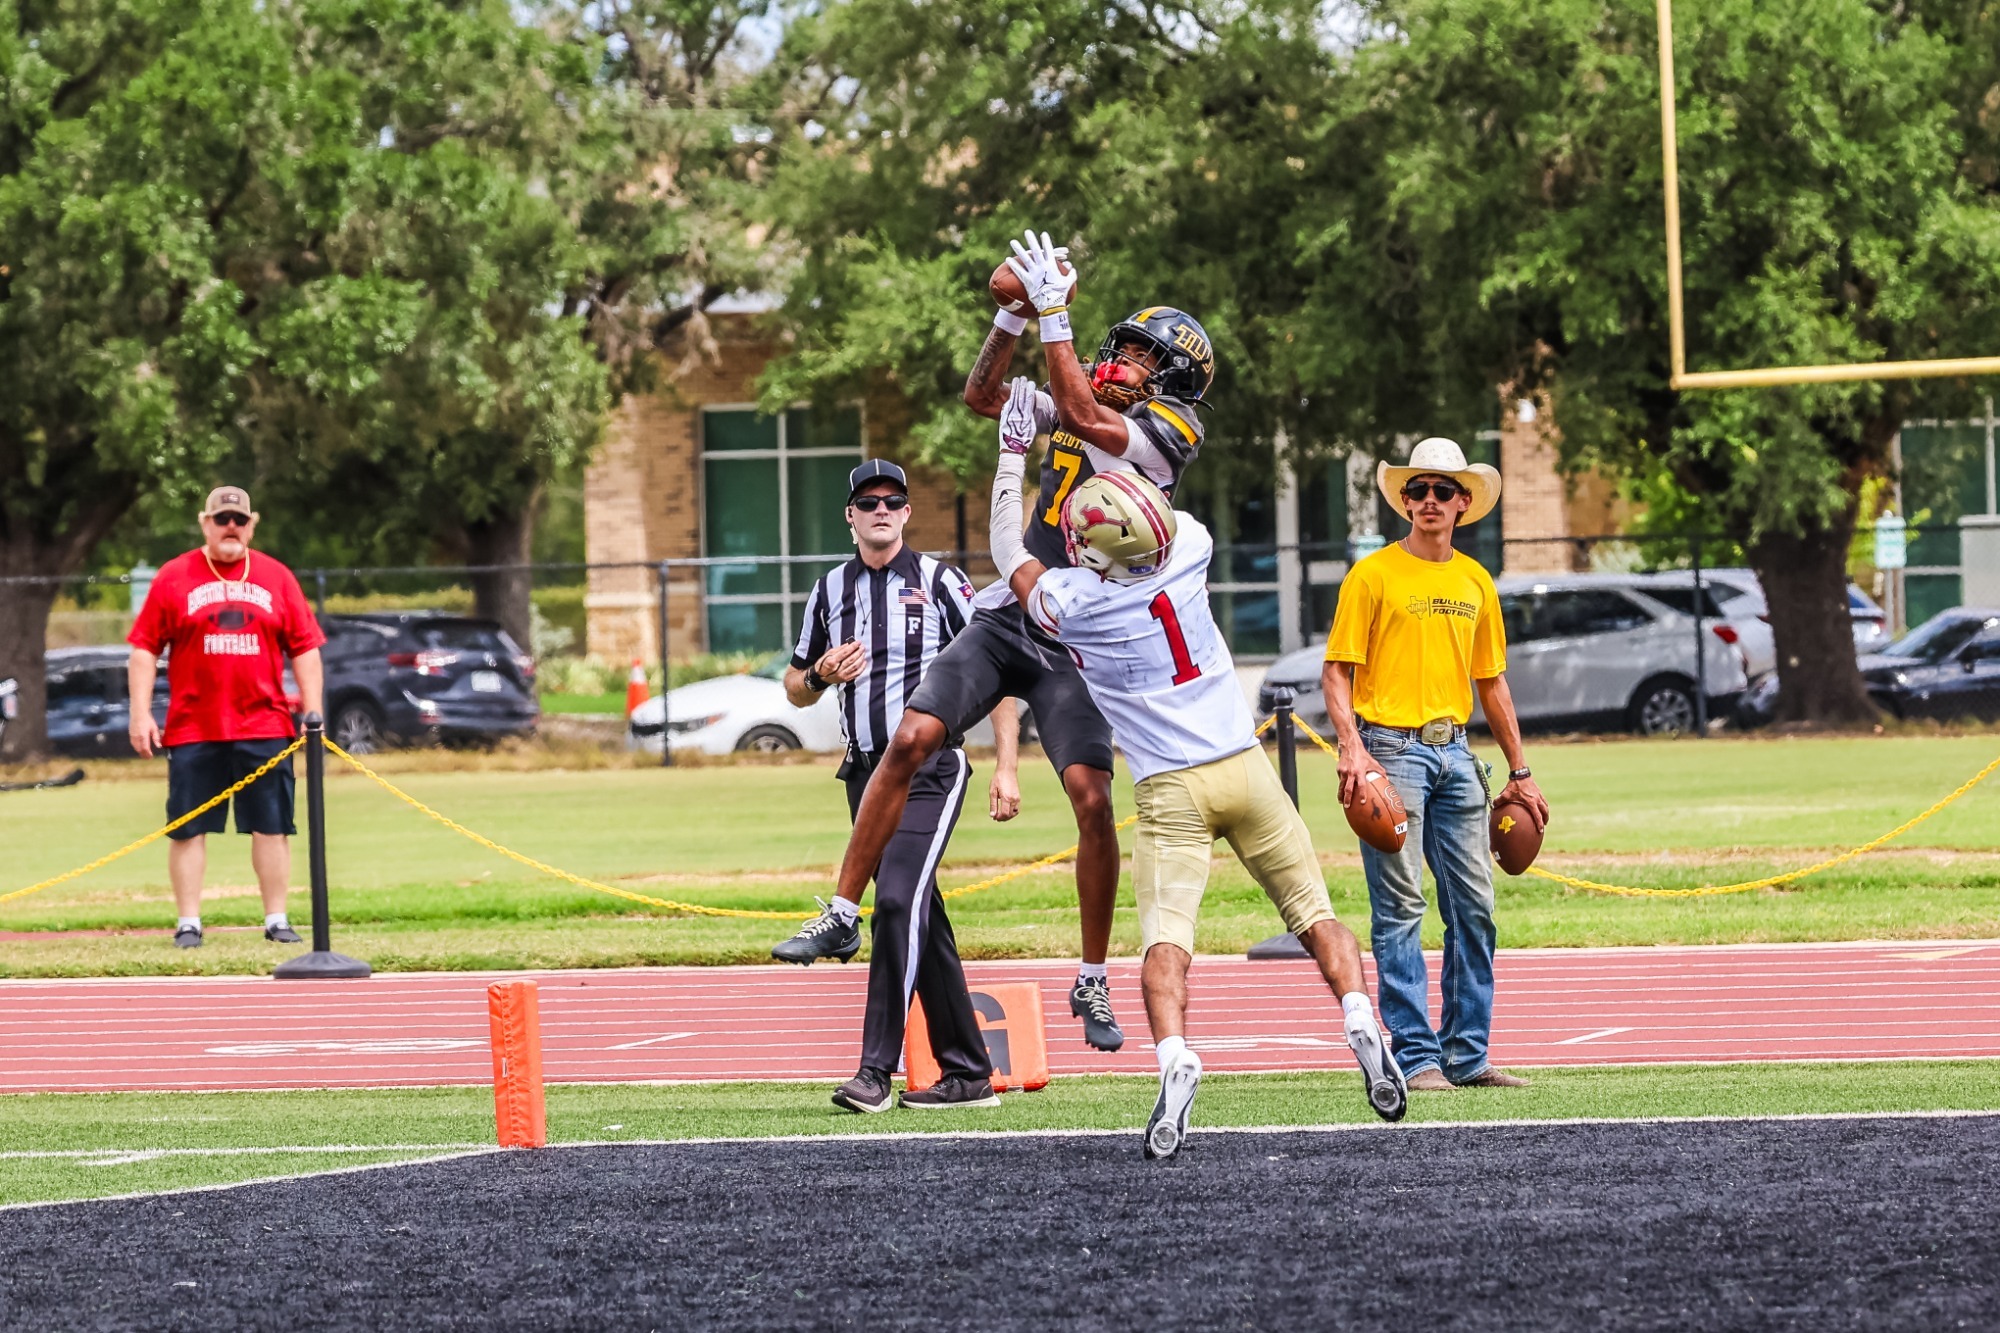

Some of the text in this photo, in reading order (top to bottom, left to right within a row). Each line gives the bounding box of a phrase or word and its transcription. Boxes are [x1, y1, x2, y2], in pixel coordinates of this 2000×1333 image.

[1043, 448, 1083, 528] 7
[1431, 598, 1477, 611] BULLDOG
[1432, 608, 1476, 621] FOOTBALL
[907, 616, 922, 635] F
[203, 632, 261, 656] FOOTBALL
[1147, 589, 1203, 687] 1
